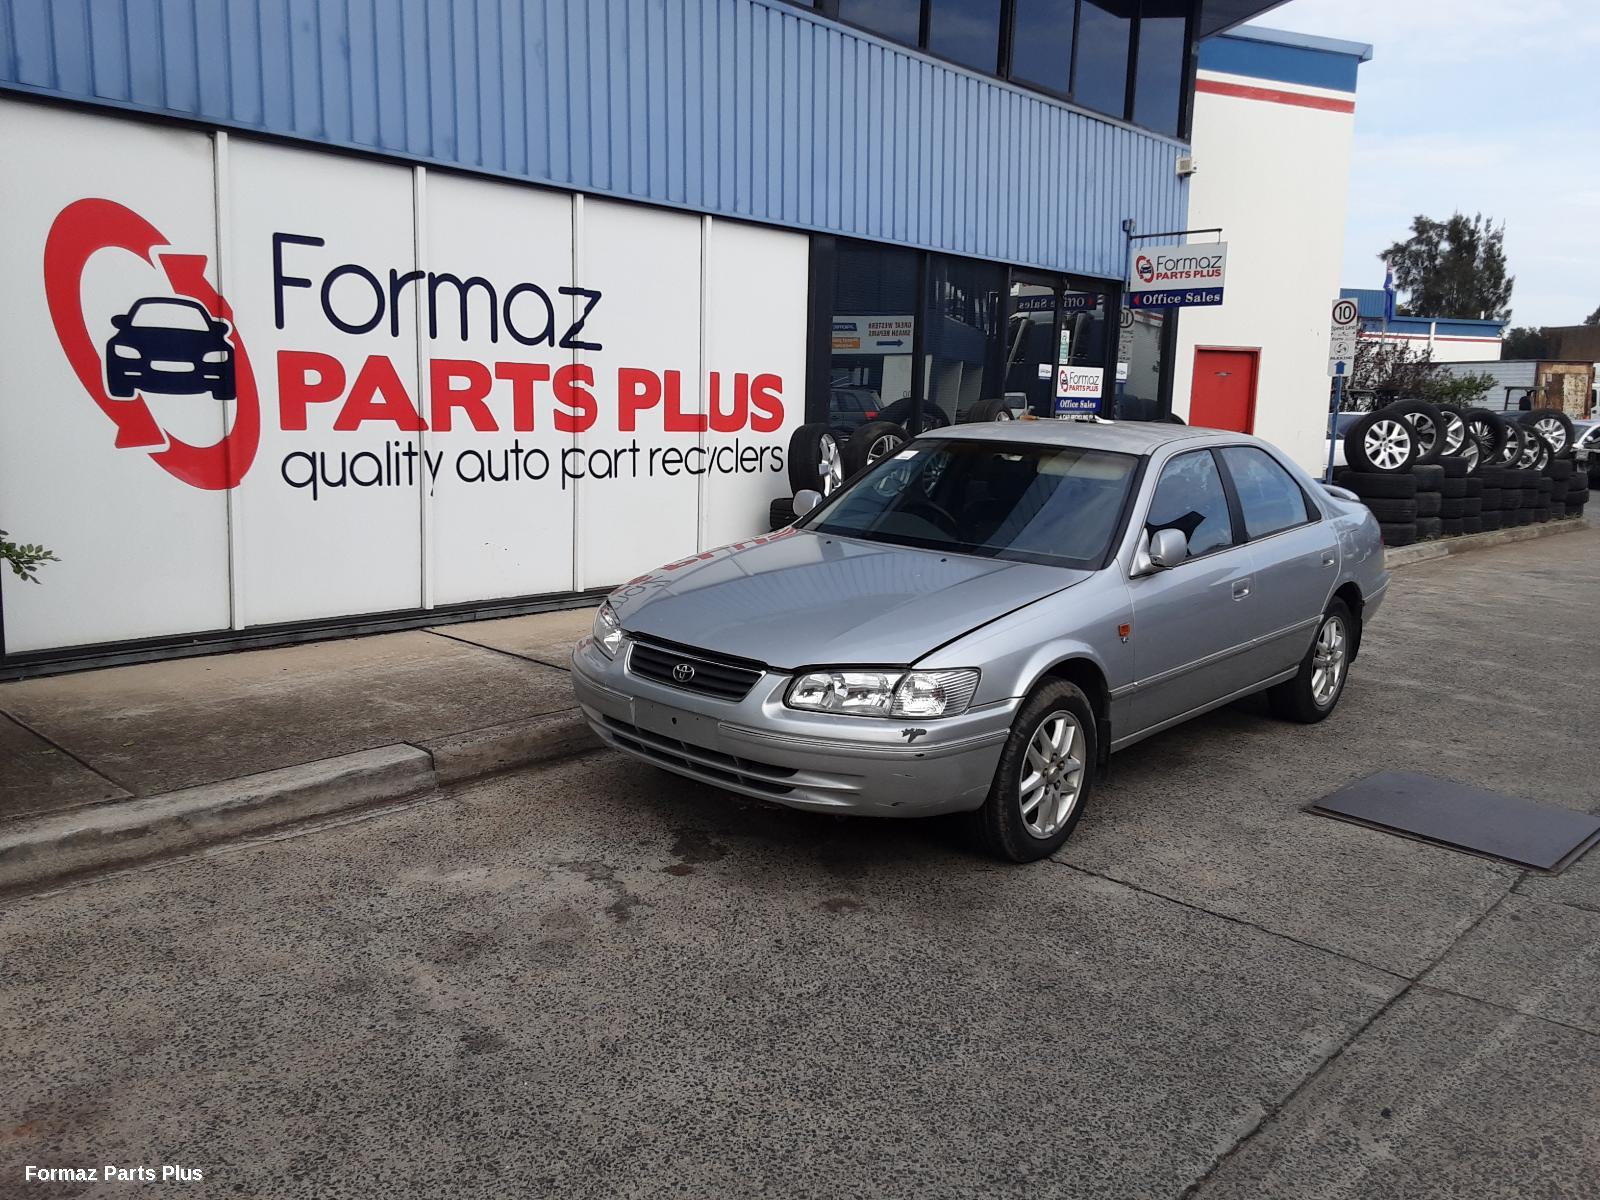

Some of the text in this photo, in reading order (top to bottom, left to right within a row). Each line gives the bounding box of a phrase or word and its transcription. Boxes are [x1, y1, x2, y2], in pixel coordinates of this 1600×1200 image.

[1156, 255, 1223, 271] Formaz
[1156, 269, 1221, 280] PARTS PLUS
[272, 232, 602, 351] Formaz
[1143, 292, 1220, 304] Office Sales
[1338, 305, 1352, 320] 10
[1069, 371, 1100, 386] Formaz
[276, 350, 785, 433] PARTS PLUS
[1069, 384, 1086, 392] PARTS
[1059, 399, 1096, 409] Office Sales
[281, 438, 785, 501] quality auto part recyclers
